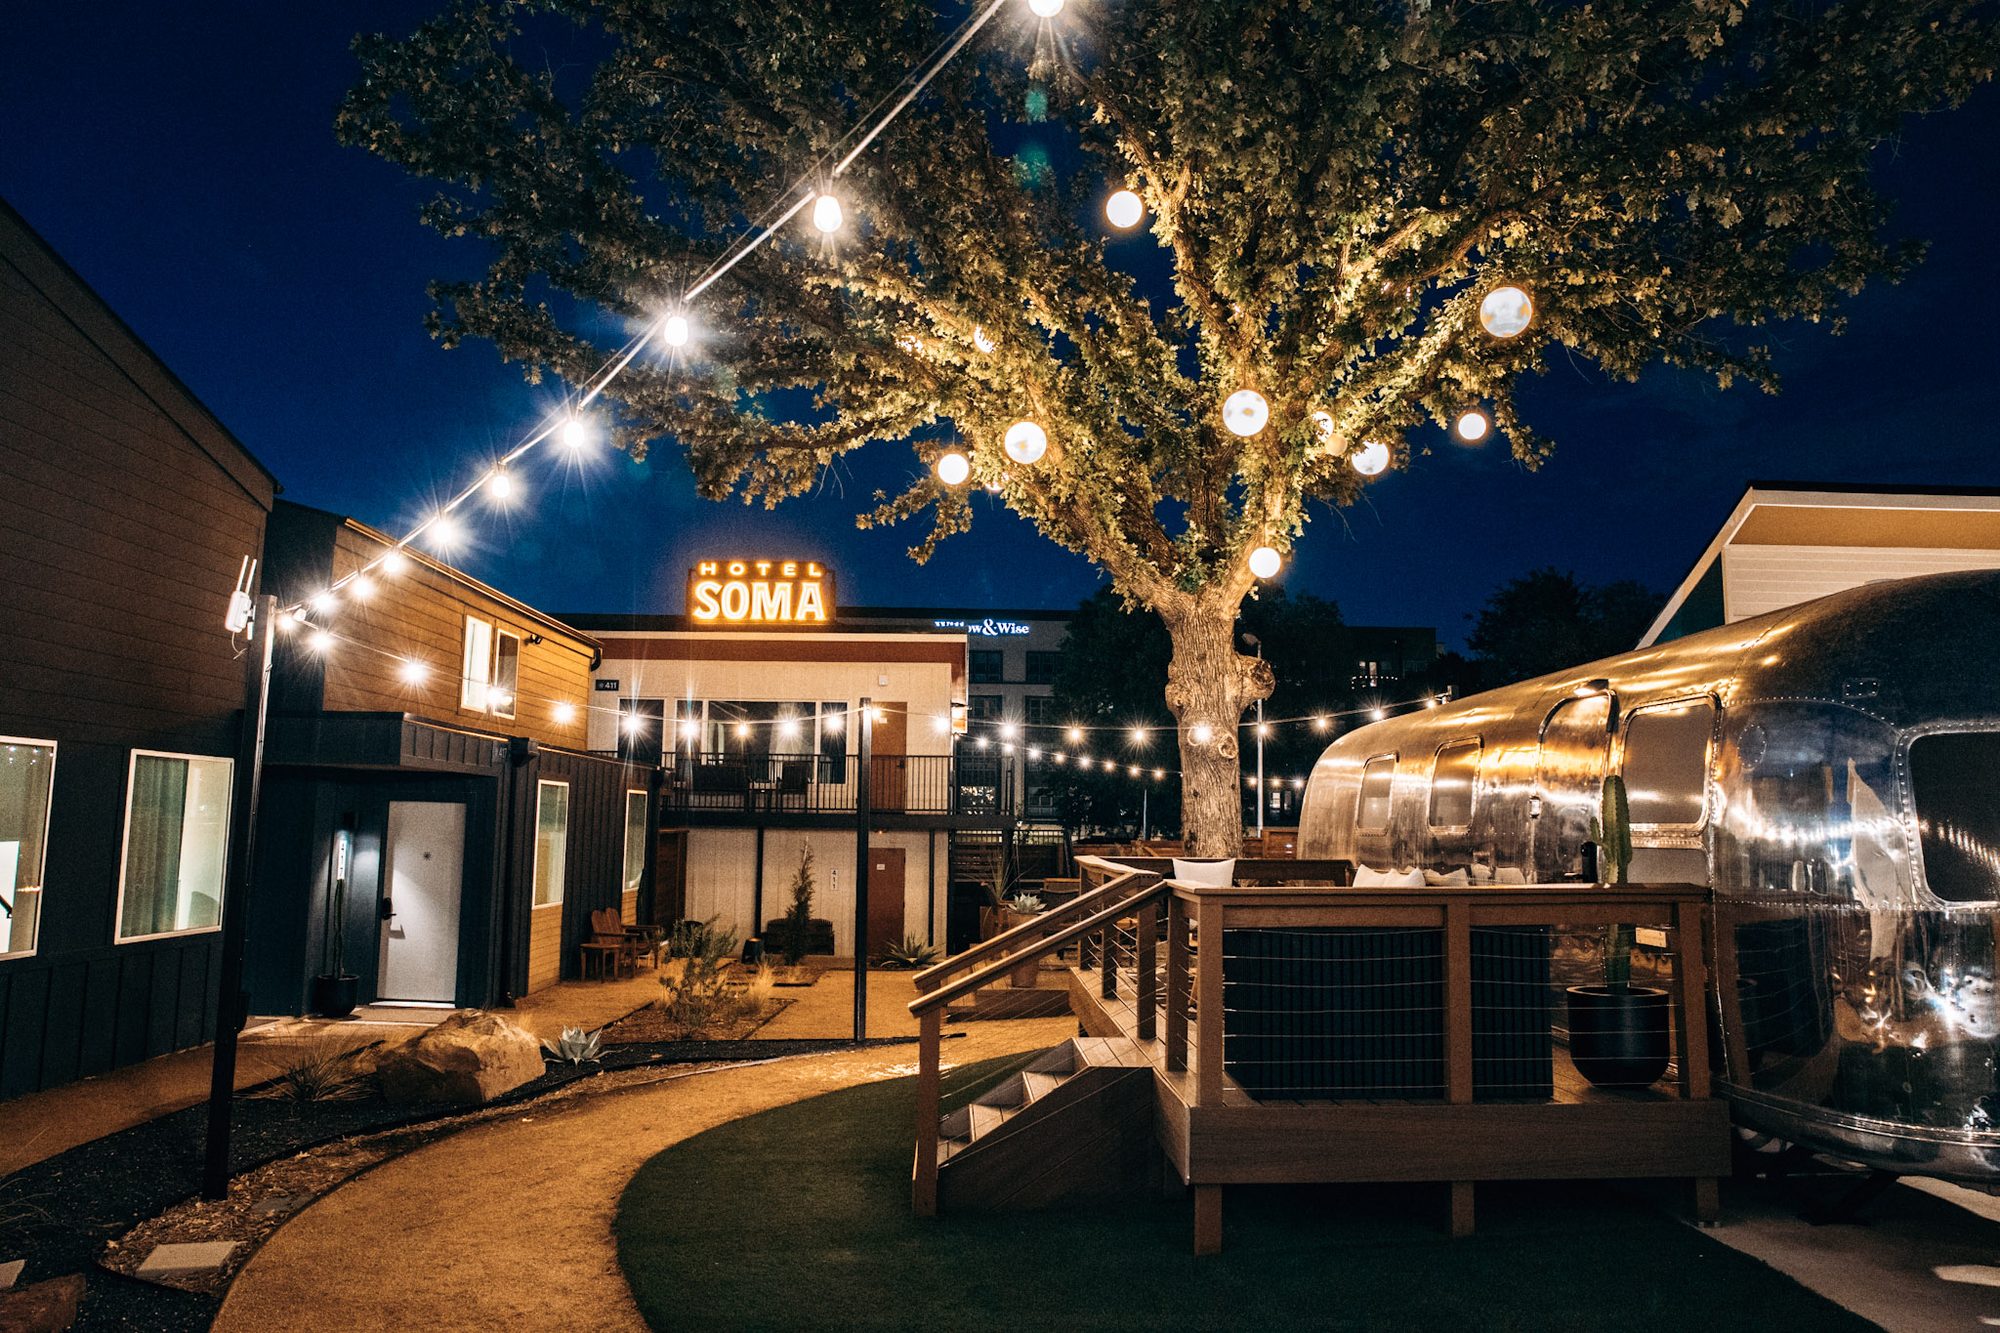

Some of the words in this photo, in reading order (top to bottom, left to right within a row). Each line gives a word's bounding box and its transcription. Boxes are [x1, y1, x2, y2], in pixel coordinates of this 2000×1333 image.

[700, 562, 822, 577] HOTEL
[692, 581, 826, 621] SOMA
[604, 681, 617, 690] 411
